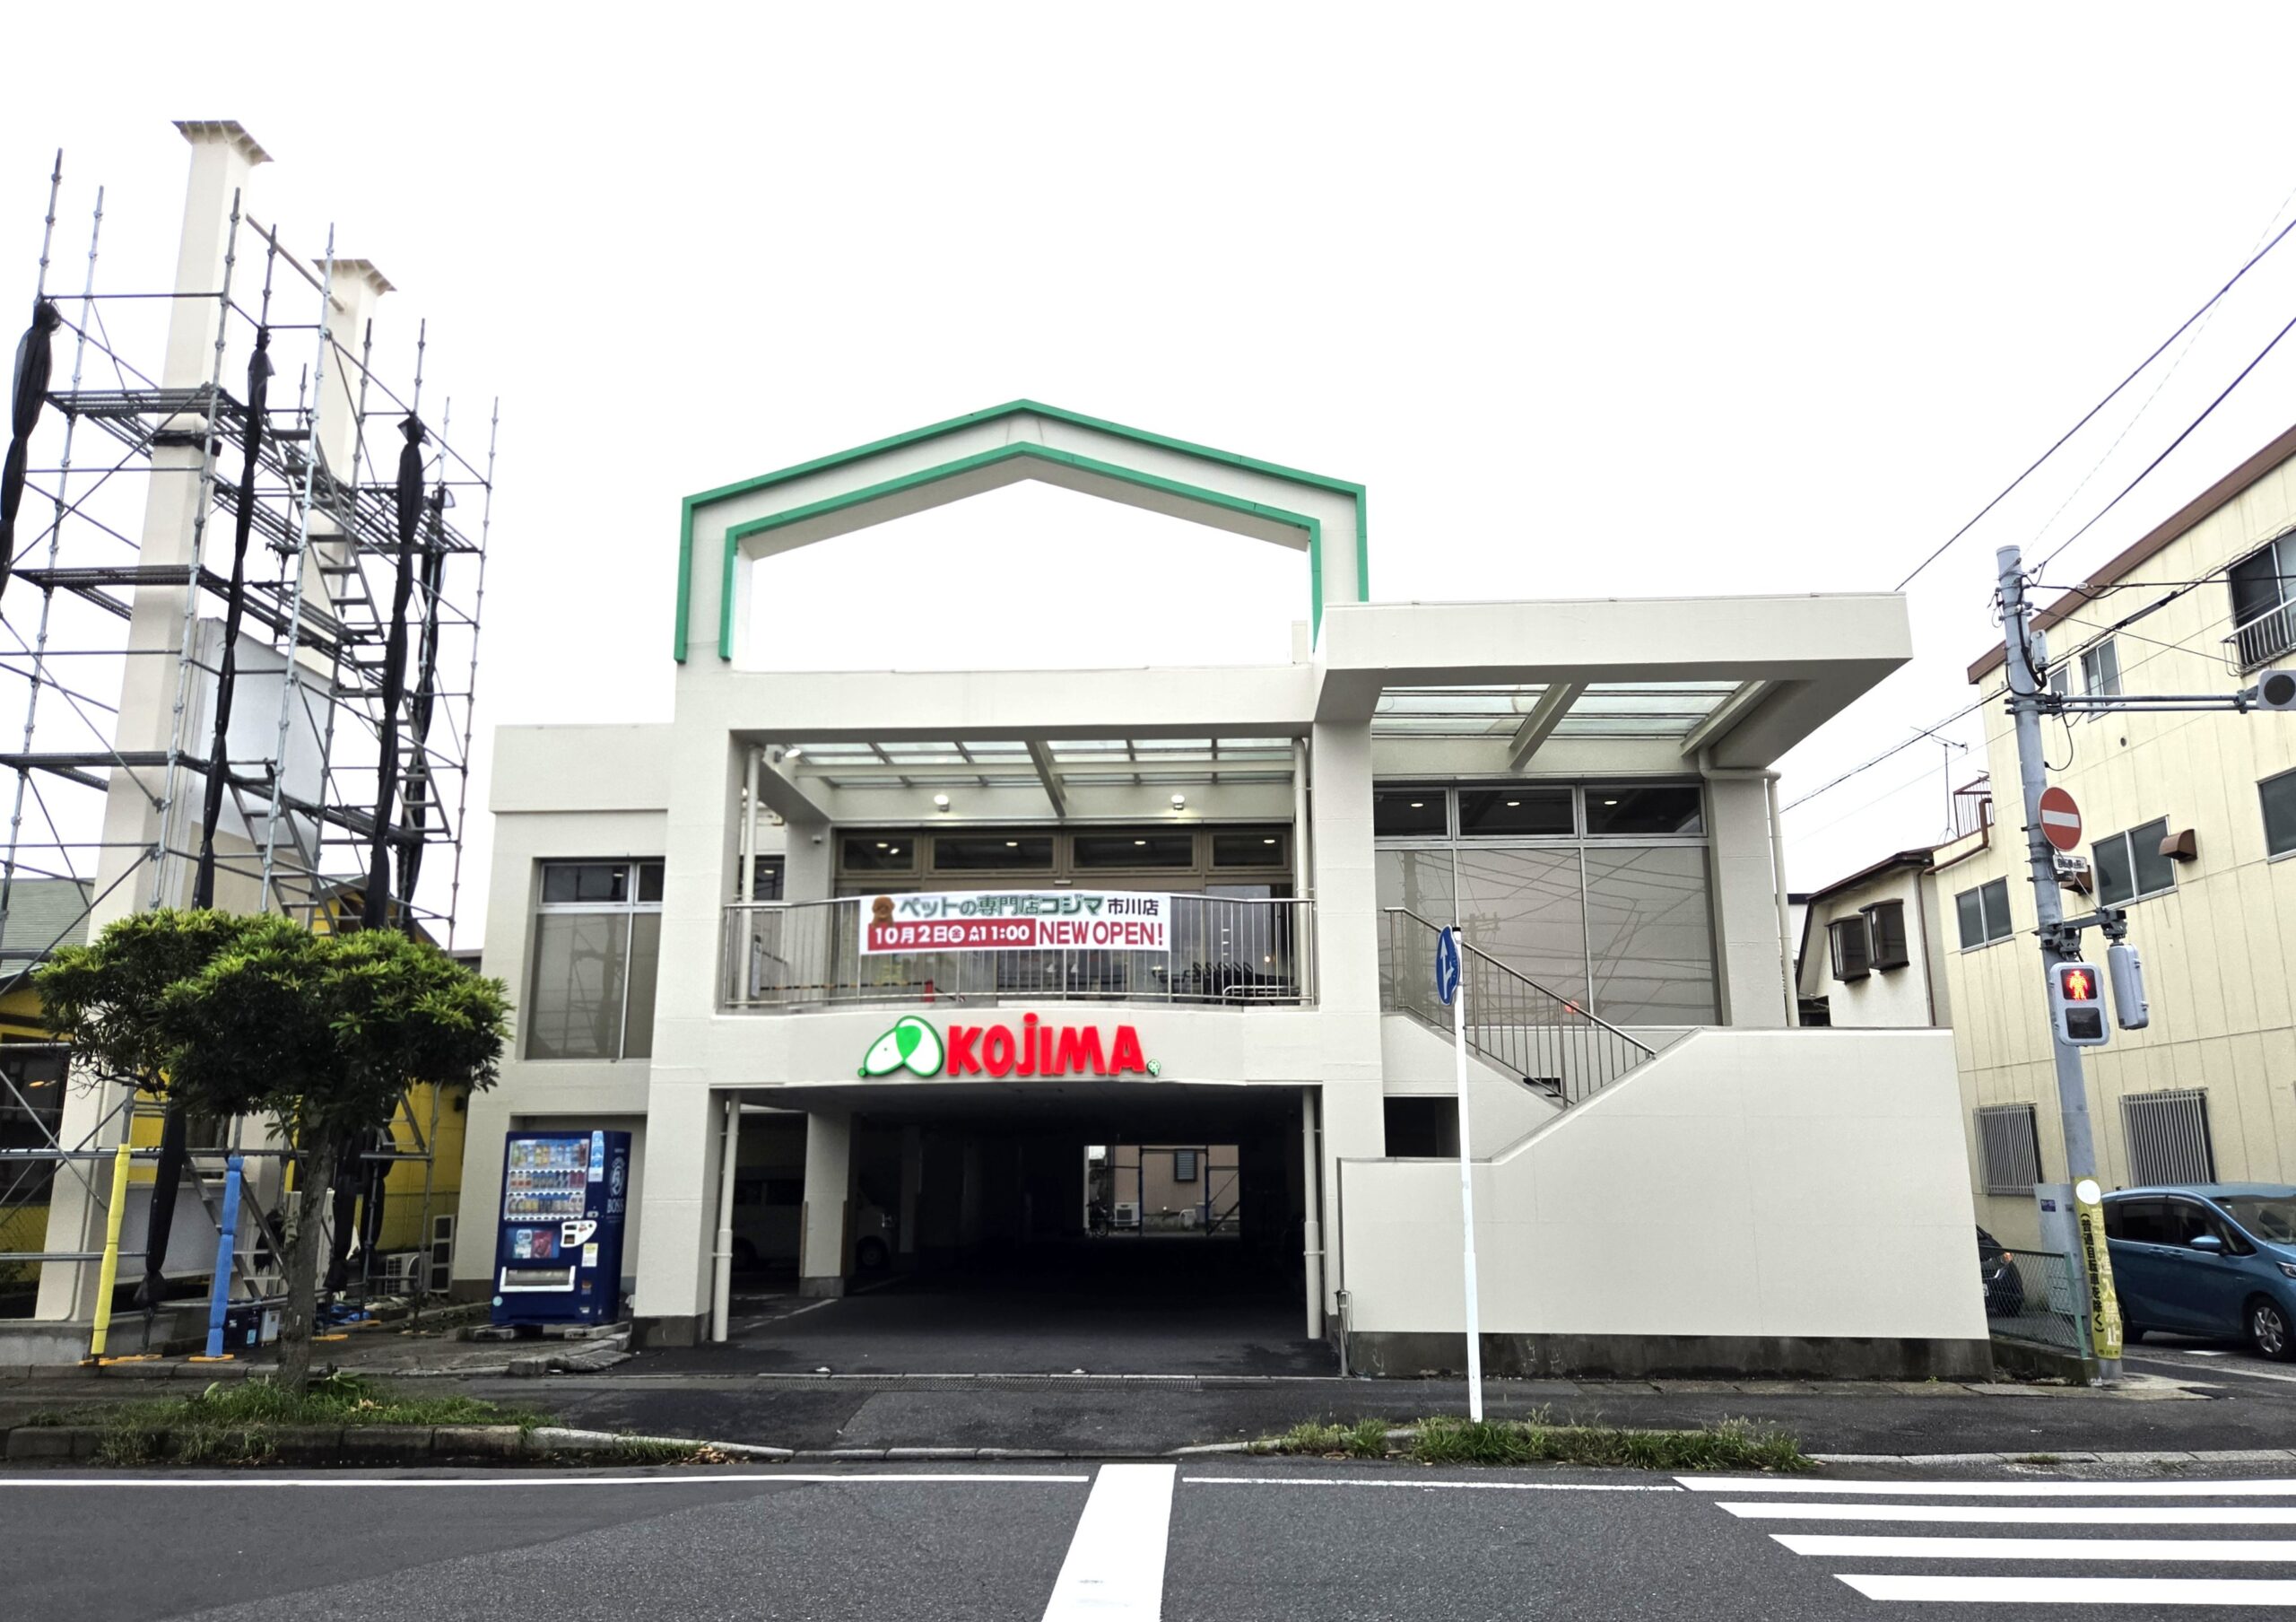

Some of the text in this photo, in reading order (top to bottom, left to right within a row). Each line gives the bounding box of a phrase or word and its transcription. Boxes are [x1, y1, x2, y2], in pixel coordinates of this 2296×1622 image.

[900, 894, 1160, 916] ペットの専門店コジマ 市川店
[1039, 921, 1162, 946] NEW OPEN!
